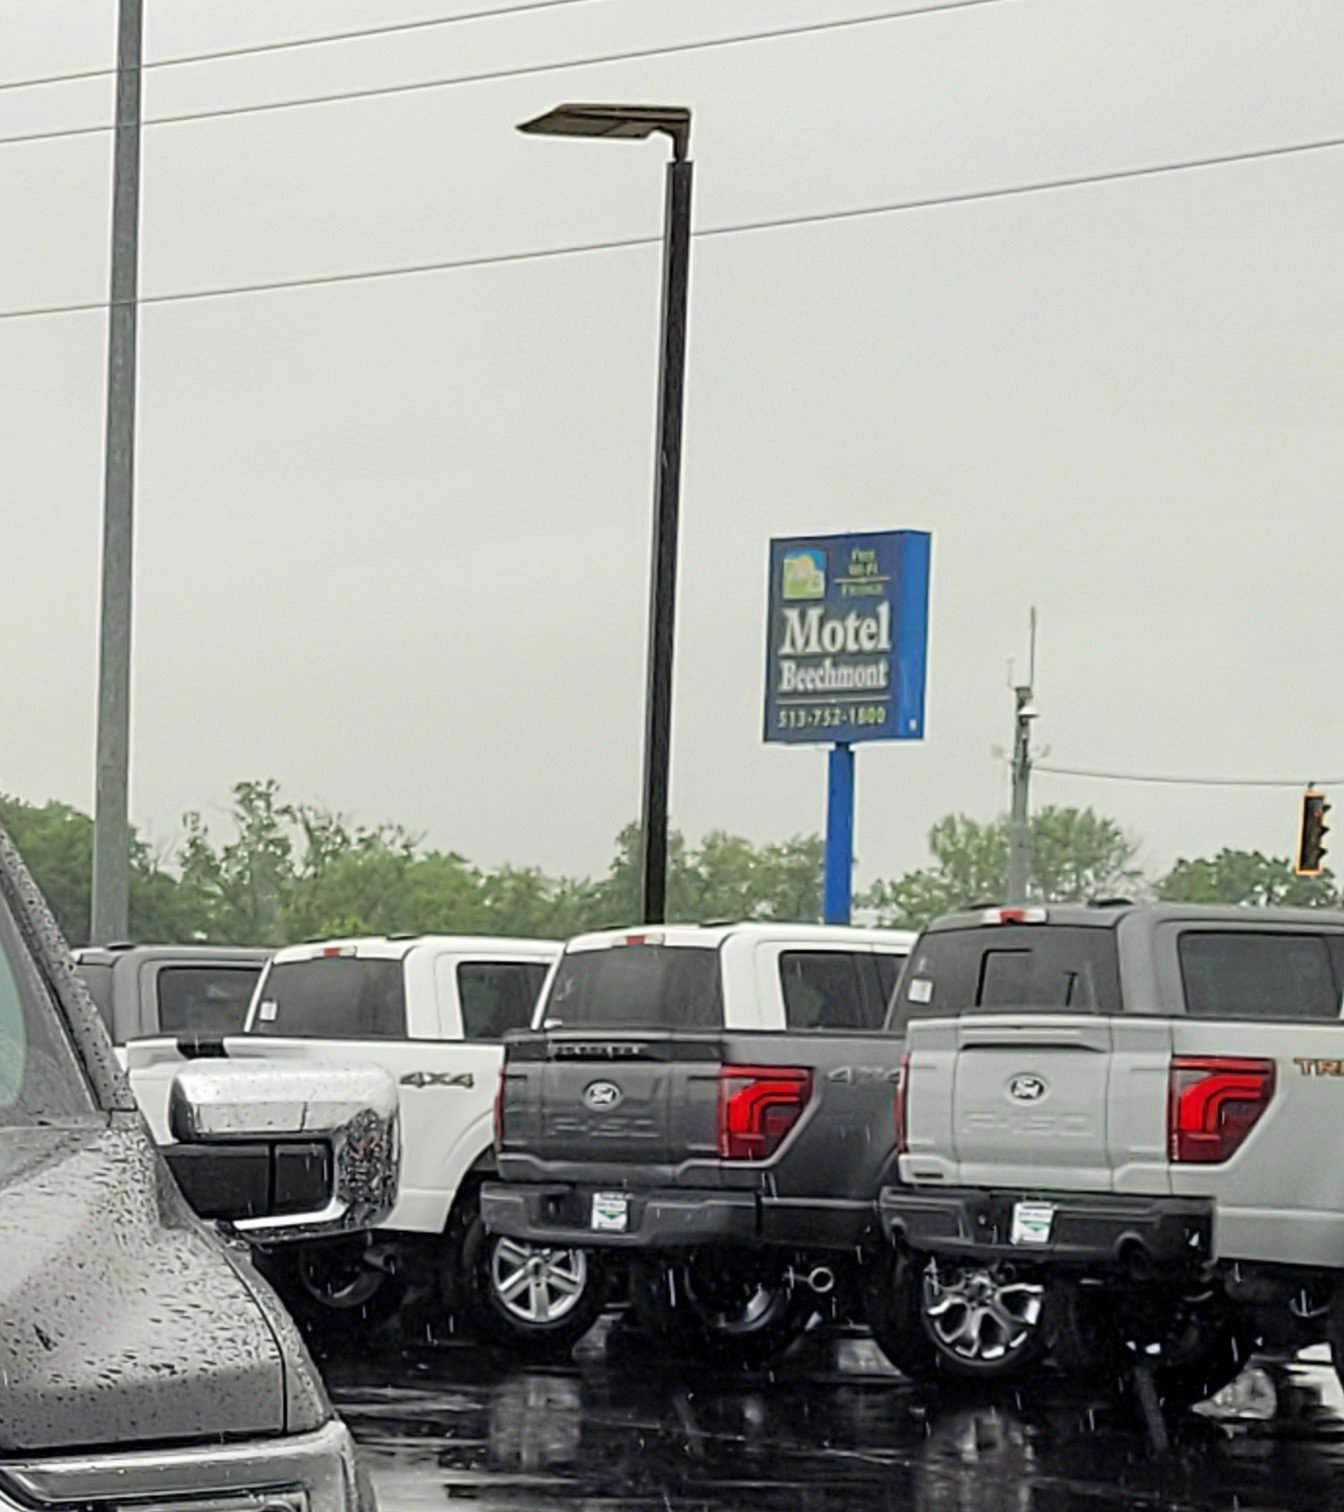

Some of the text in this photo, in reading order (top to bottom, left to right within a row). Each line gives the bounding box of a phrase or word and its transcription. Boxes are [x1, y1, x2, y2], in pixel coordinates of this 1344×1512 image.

[778, 601, 892, 656] Motel
[779, 657, 889, 693] Beechmont
[1293, 1057, 1344, 1076] TR
